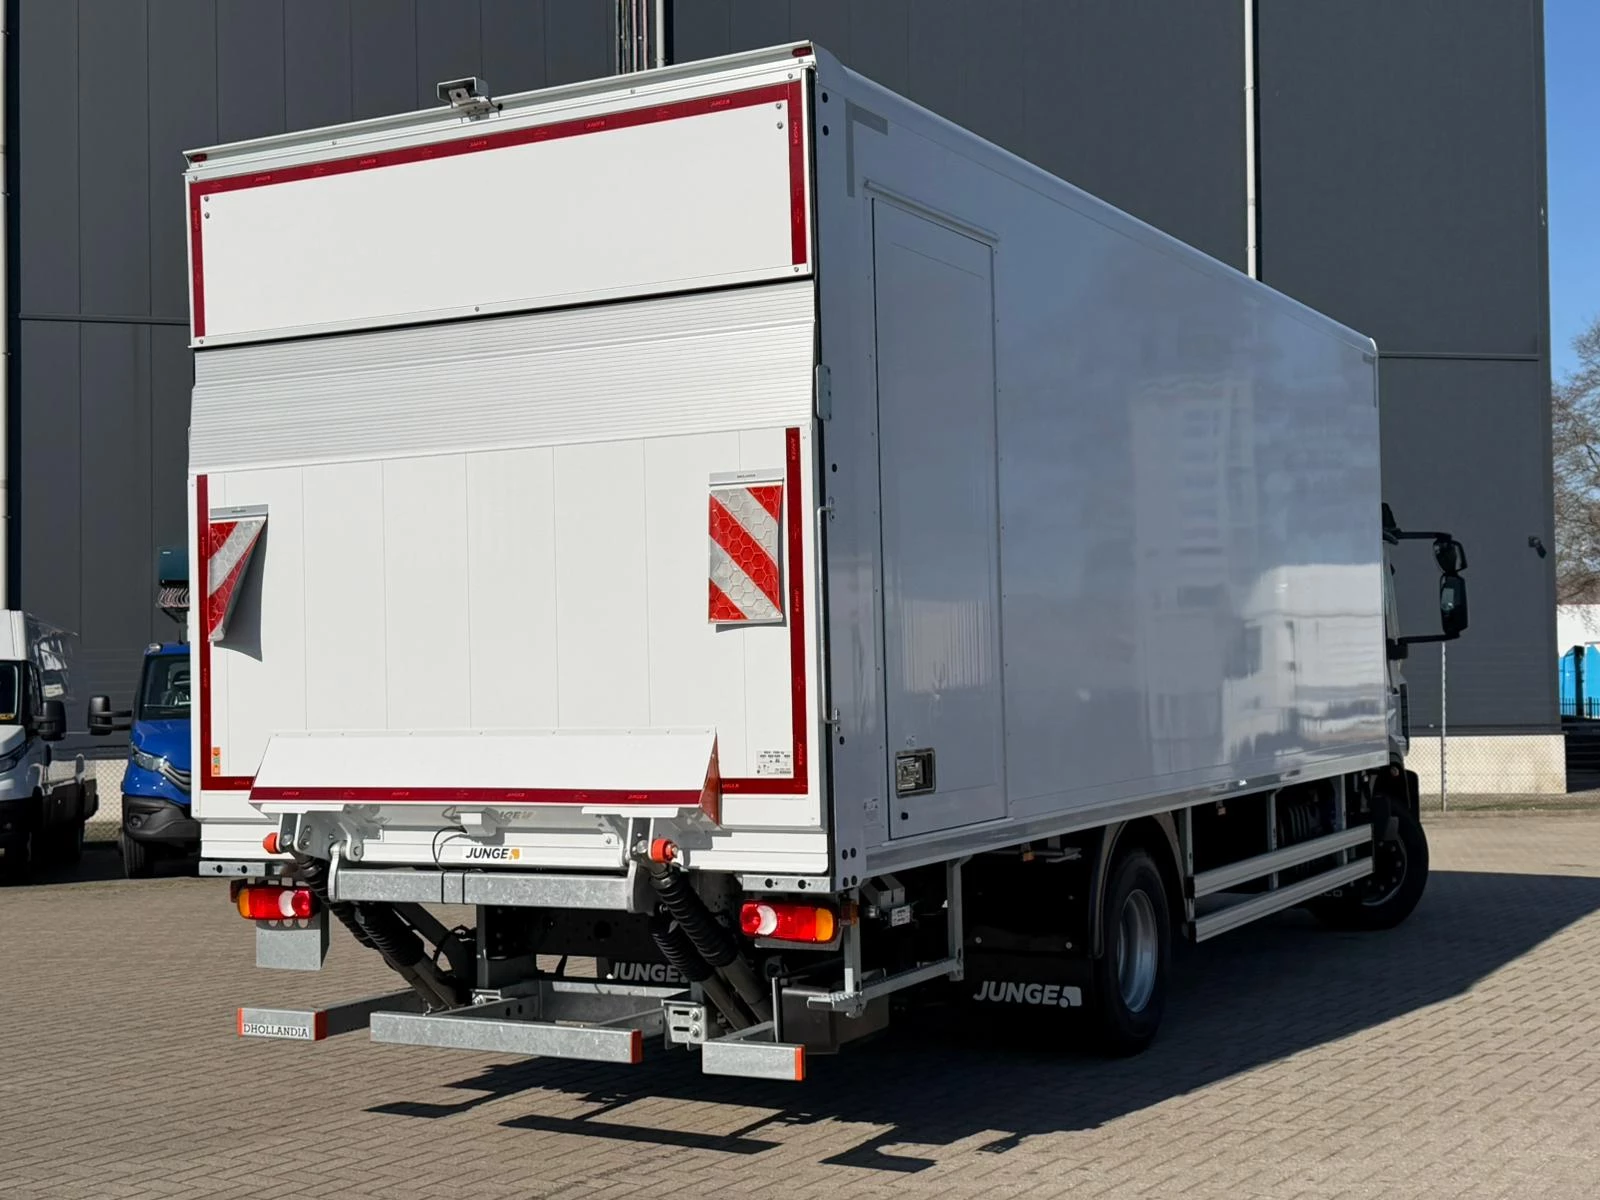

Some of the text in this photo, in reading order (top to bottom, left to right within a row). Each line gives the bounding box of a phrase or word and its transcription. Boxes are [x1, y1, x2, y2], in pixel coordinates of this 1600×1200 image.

[466, 848, 510, 859] JUNGE
[606, 962, 680, 982] JUNGE
[973, 981, 1061, 1006] JUNGE
[243, 1024, 309, 1038] DHOLLANDIA
